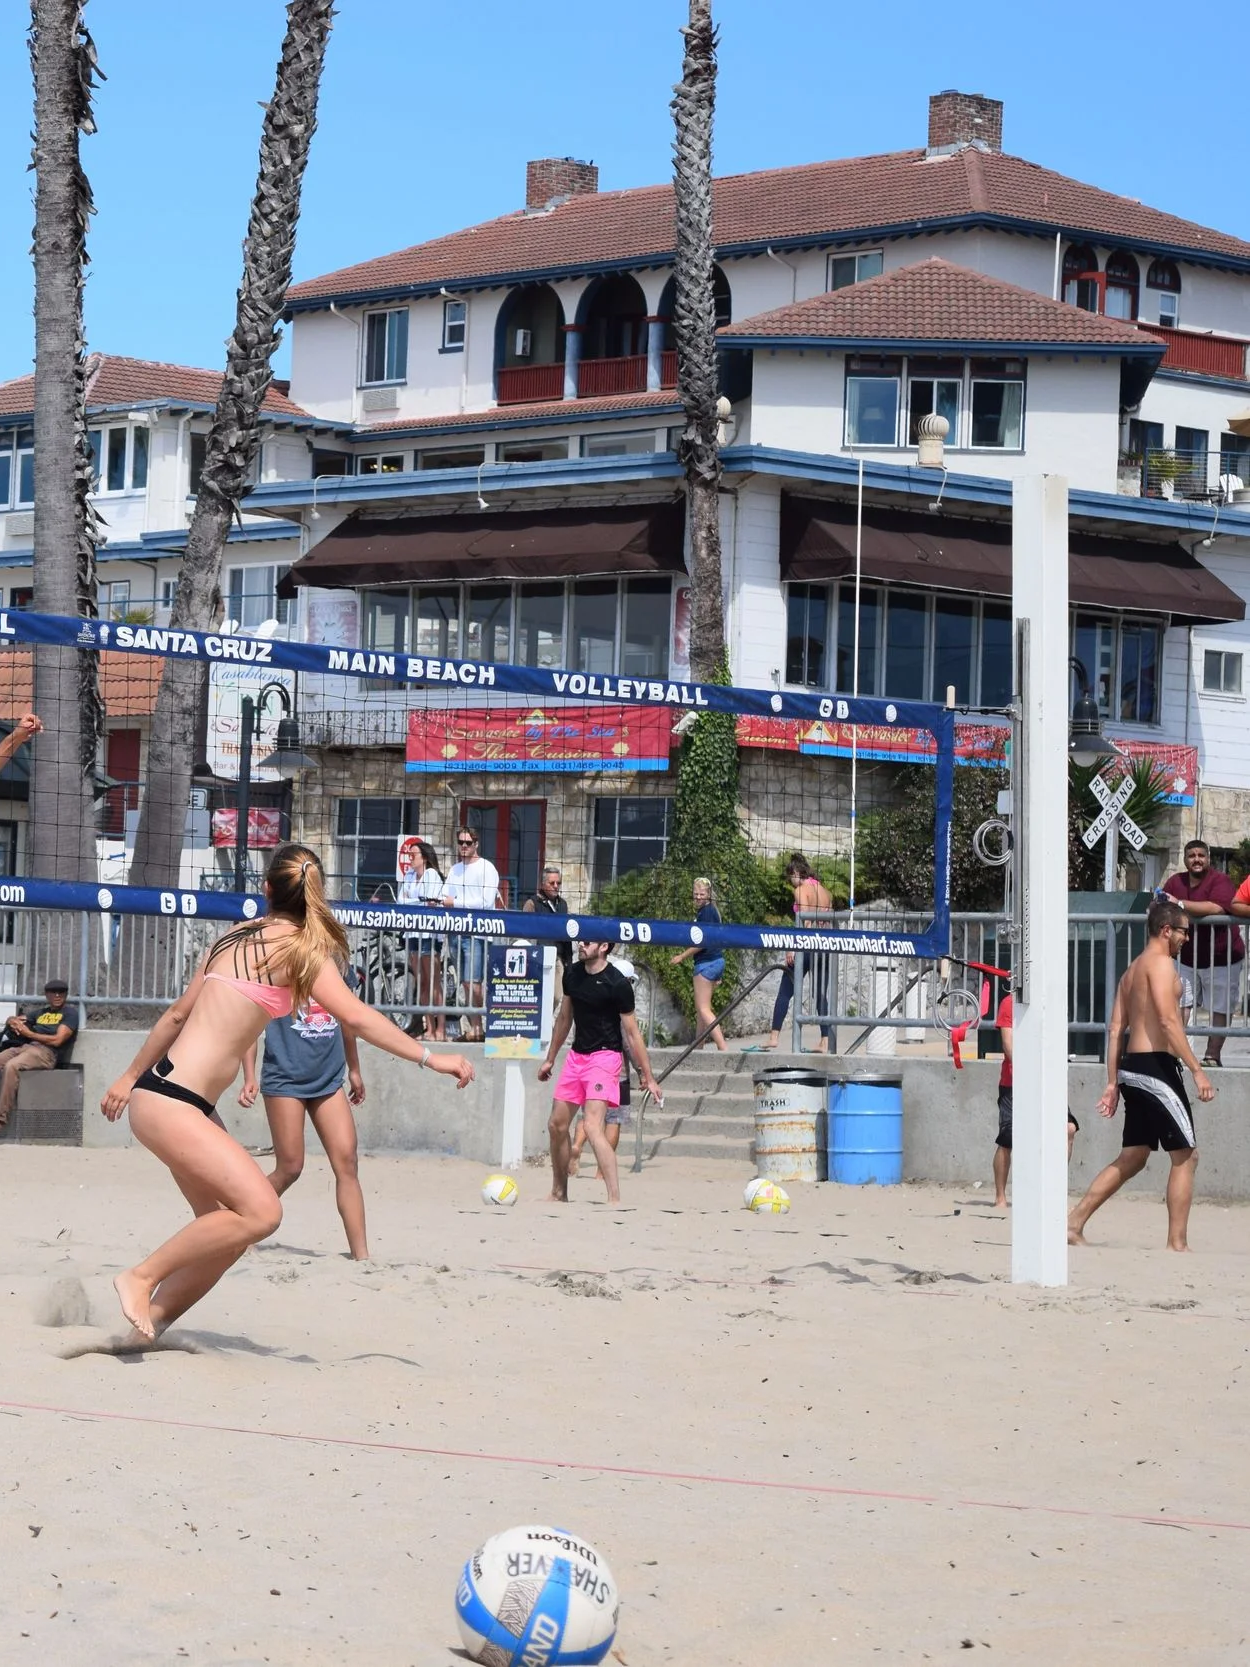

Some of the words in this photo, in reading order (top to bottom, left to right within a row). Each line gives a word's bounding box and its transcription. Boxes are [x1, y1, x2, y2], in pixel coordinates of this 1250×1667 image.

[115, 626, 199, 656] SANTA
[204, 636, 273, 662] CRUZ
[328, 650, 396, 676] MAIN
[406, 658, 497, 686] BEACH
[552, 672, 709, 706] VOLLEYBALL
[525, 724, 543, 741] by
[550, 726, 579, 739] The
[468, 742, 520, 760] Thai
[525, 741, 603, 760] Cuisine
[521, 761, 539, 770] Fax
[1086, 779, 1134, 844] CROSSING
[1118, 815, 1144, 846] ROAD
[760, 931, 916, 956] www.santacruzwharf.com
[760, 1099, 786, 1107] TRASH
[526, 1532, 599, 1567] Wilson
